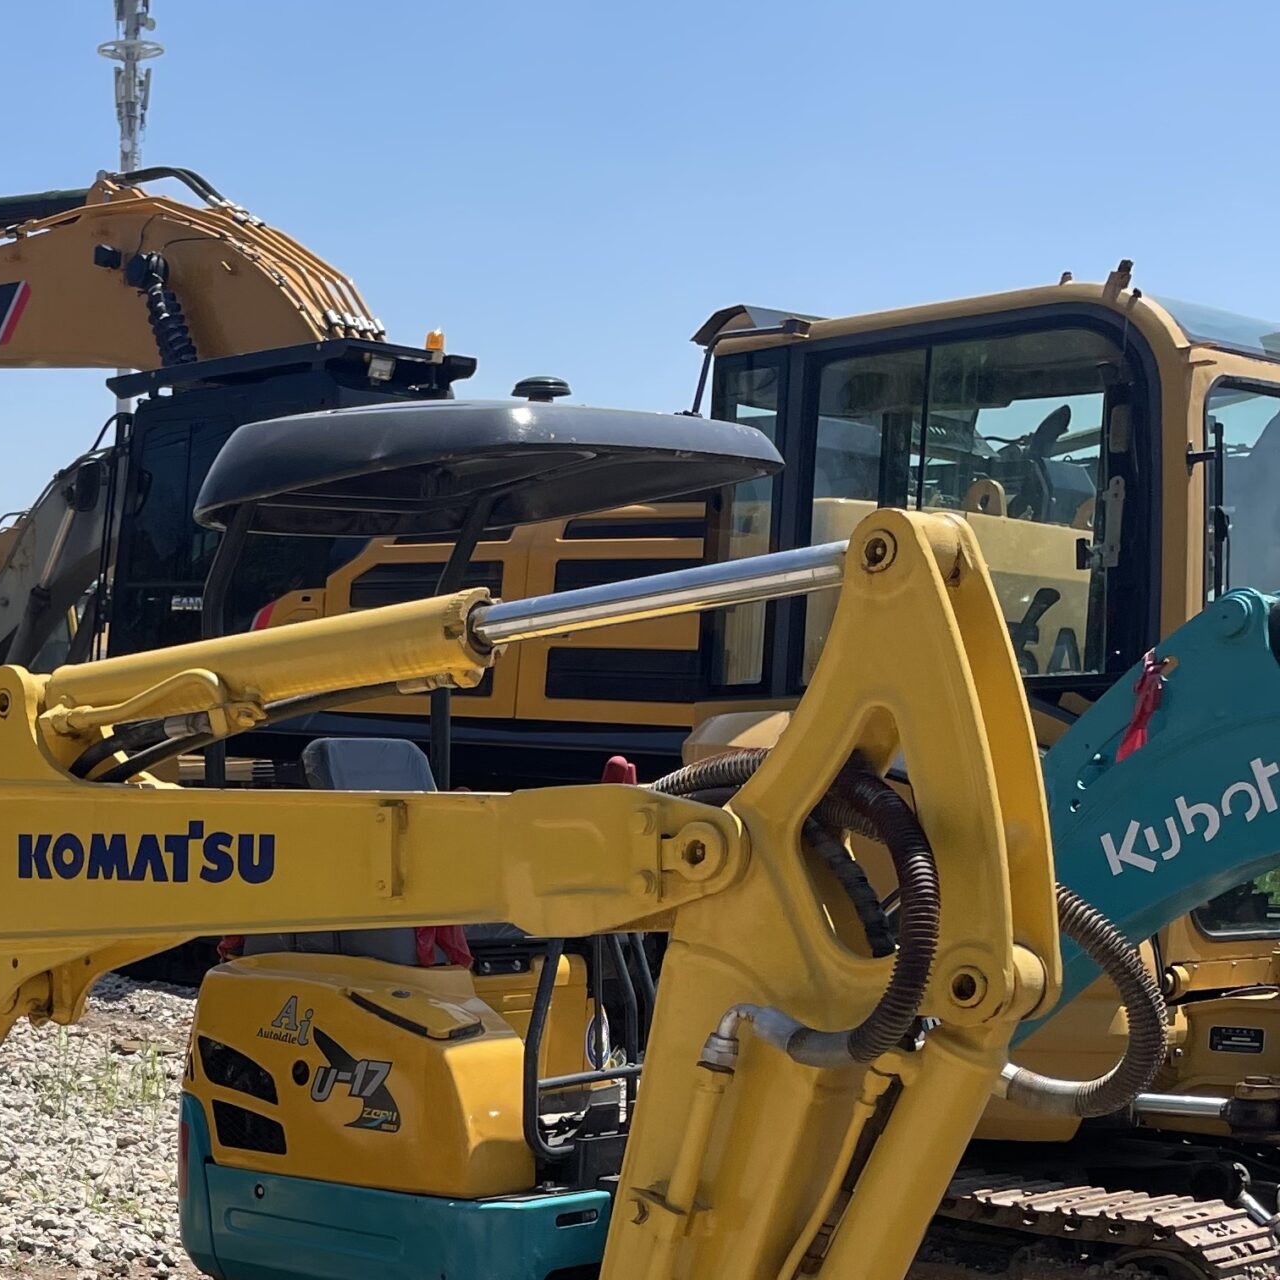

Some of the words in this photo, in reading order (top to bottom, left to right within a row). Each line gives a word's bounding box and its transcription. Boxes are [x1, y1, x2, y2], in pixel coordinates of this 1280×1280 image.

[1100, 757, 1280, 876] Kubot
[18, 820, 275, 884] KOMATSU
[271, 995, 314, 1046] Ai
[310, 1059, 393, 1102] U-17
